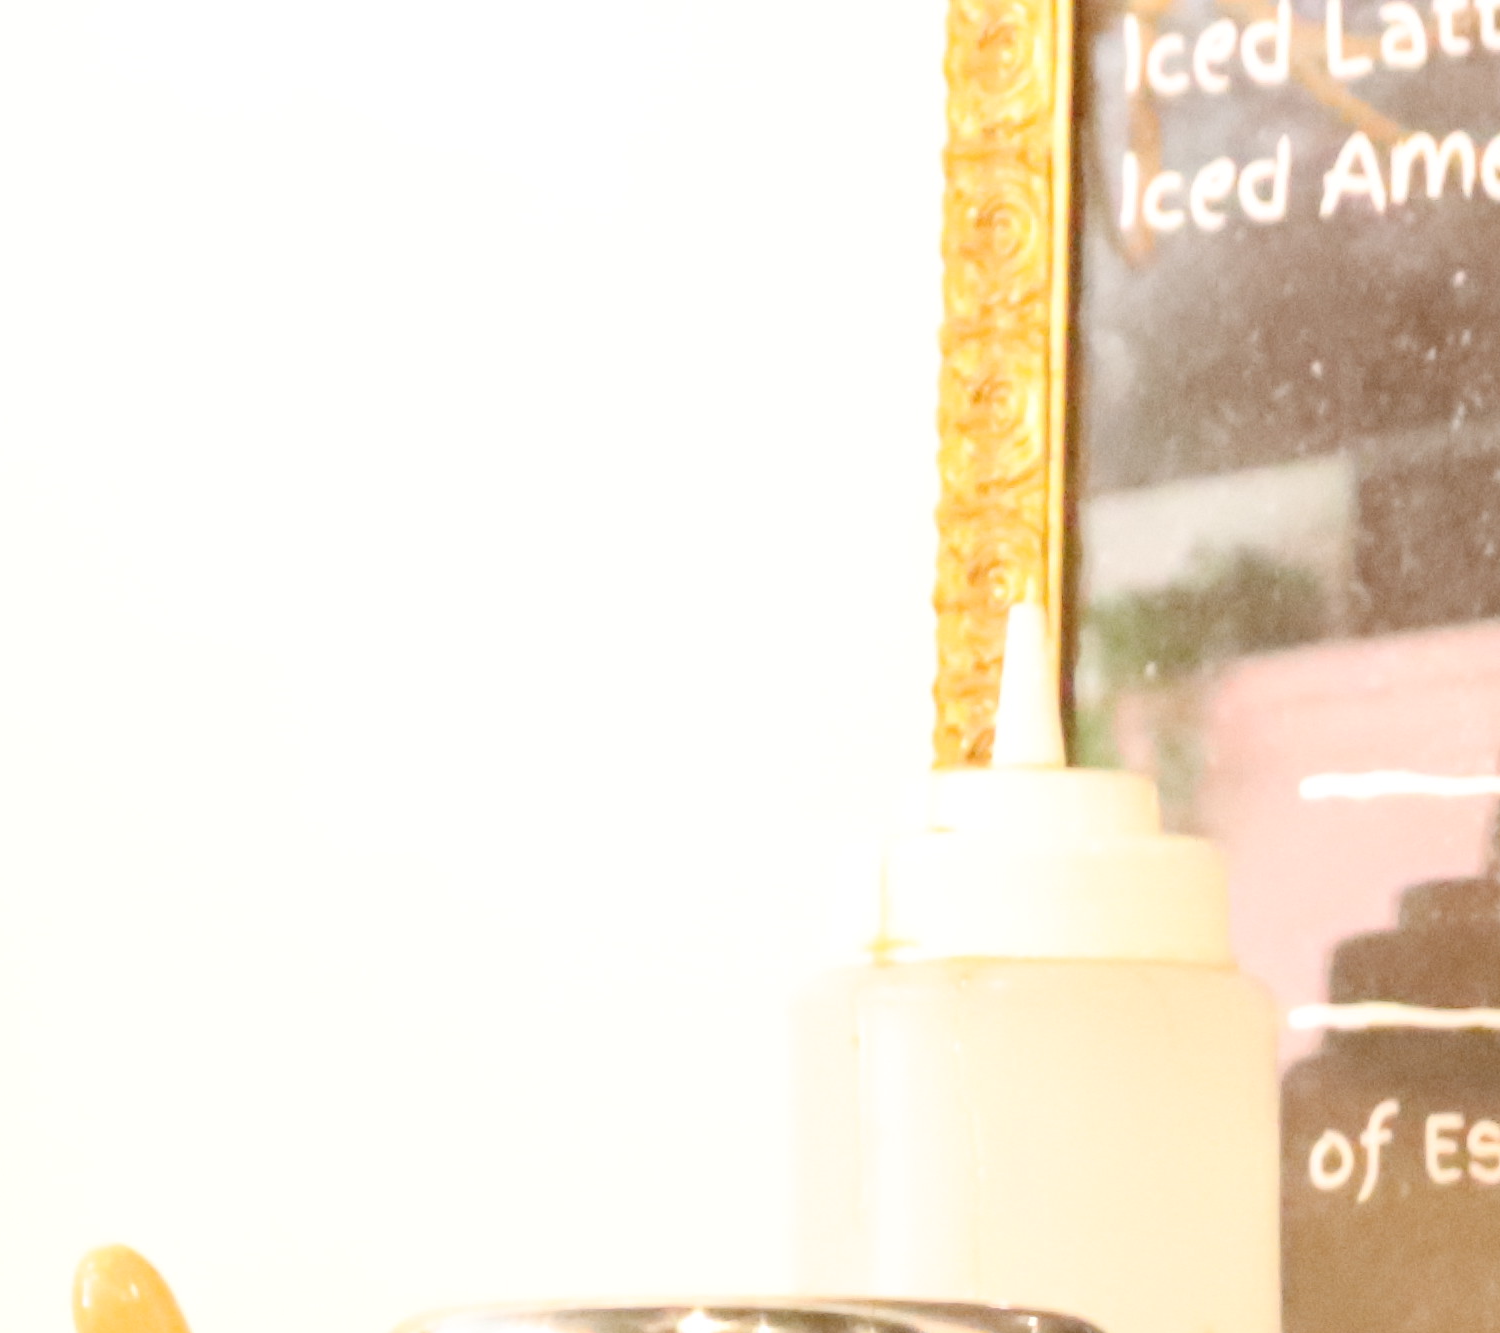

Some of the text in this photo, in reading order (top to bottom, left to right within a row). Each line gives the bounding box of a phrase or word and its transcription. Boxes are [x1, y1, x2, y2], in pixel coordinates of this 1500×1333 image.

[1124, 0, 1291, 96] Iced
[1120, 132, 1290, 231] Iced
[1307, 1098, 1400, 1204] of
